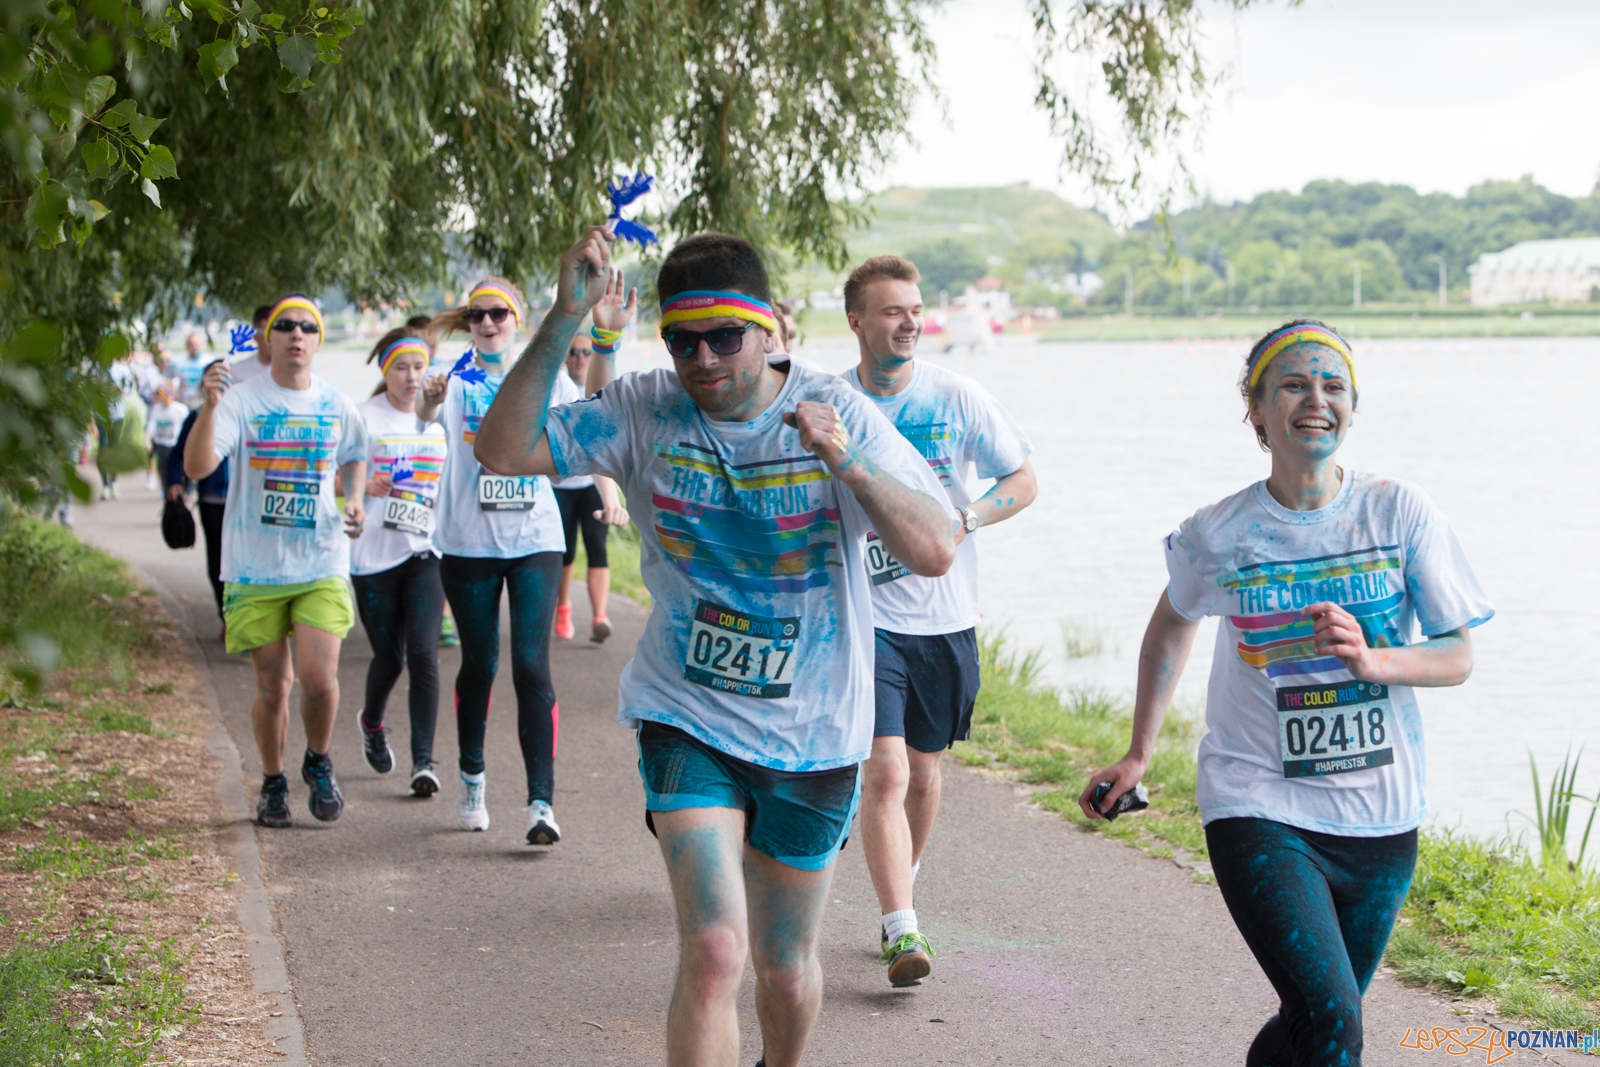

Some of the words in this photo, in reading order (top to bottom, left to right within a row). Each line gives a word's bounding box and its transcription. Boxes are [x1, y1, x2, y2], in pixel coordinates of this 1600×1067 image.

[483, 478, 535, 500] 02041
[671, 466, 710, 502] THE
[764, 484, 810, 518] RUN
[265, 494, 316, 518] 02420
[388, 501, 430, 529] 02486
[1236, 585, 1275, 614] THE
[1350, 571, 1390, 601] RUN
[702, 606, 719, 623] THE
[718, 612, 751, 631] COLOR
[750, 621, 772, 636] RUN
[693, 629, 794, 680] 02417
[711, 677, 763, 696] #HAPPIEST5K
[1284, 692, 1304, 707] THE
[1303, 689, 1338, 706] COLOR
[1337, 687, 1359, 703] RUN
[1286, 707, 1386, 756] 02418
[1314, 756, 1368, 773] #HAPPIEST5K
